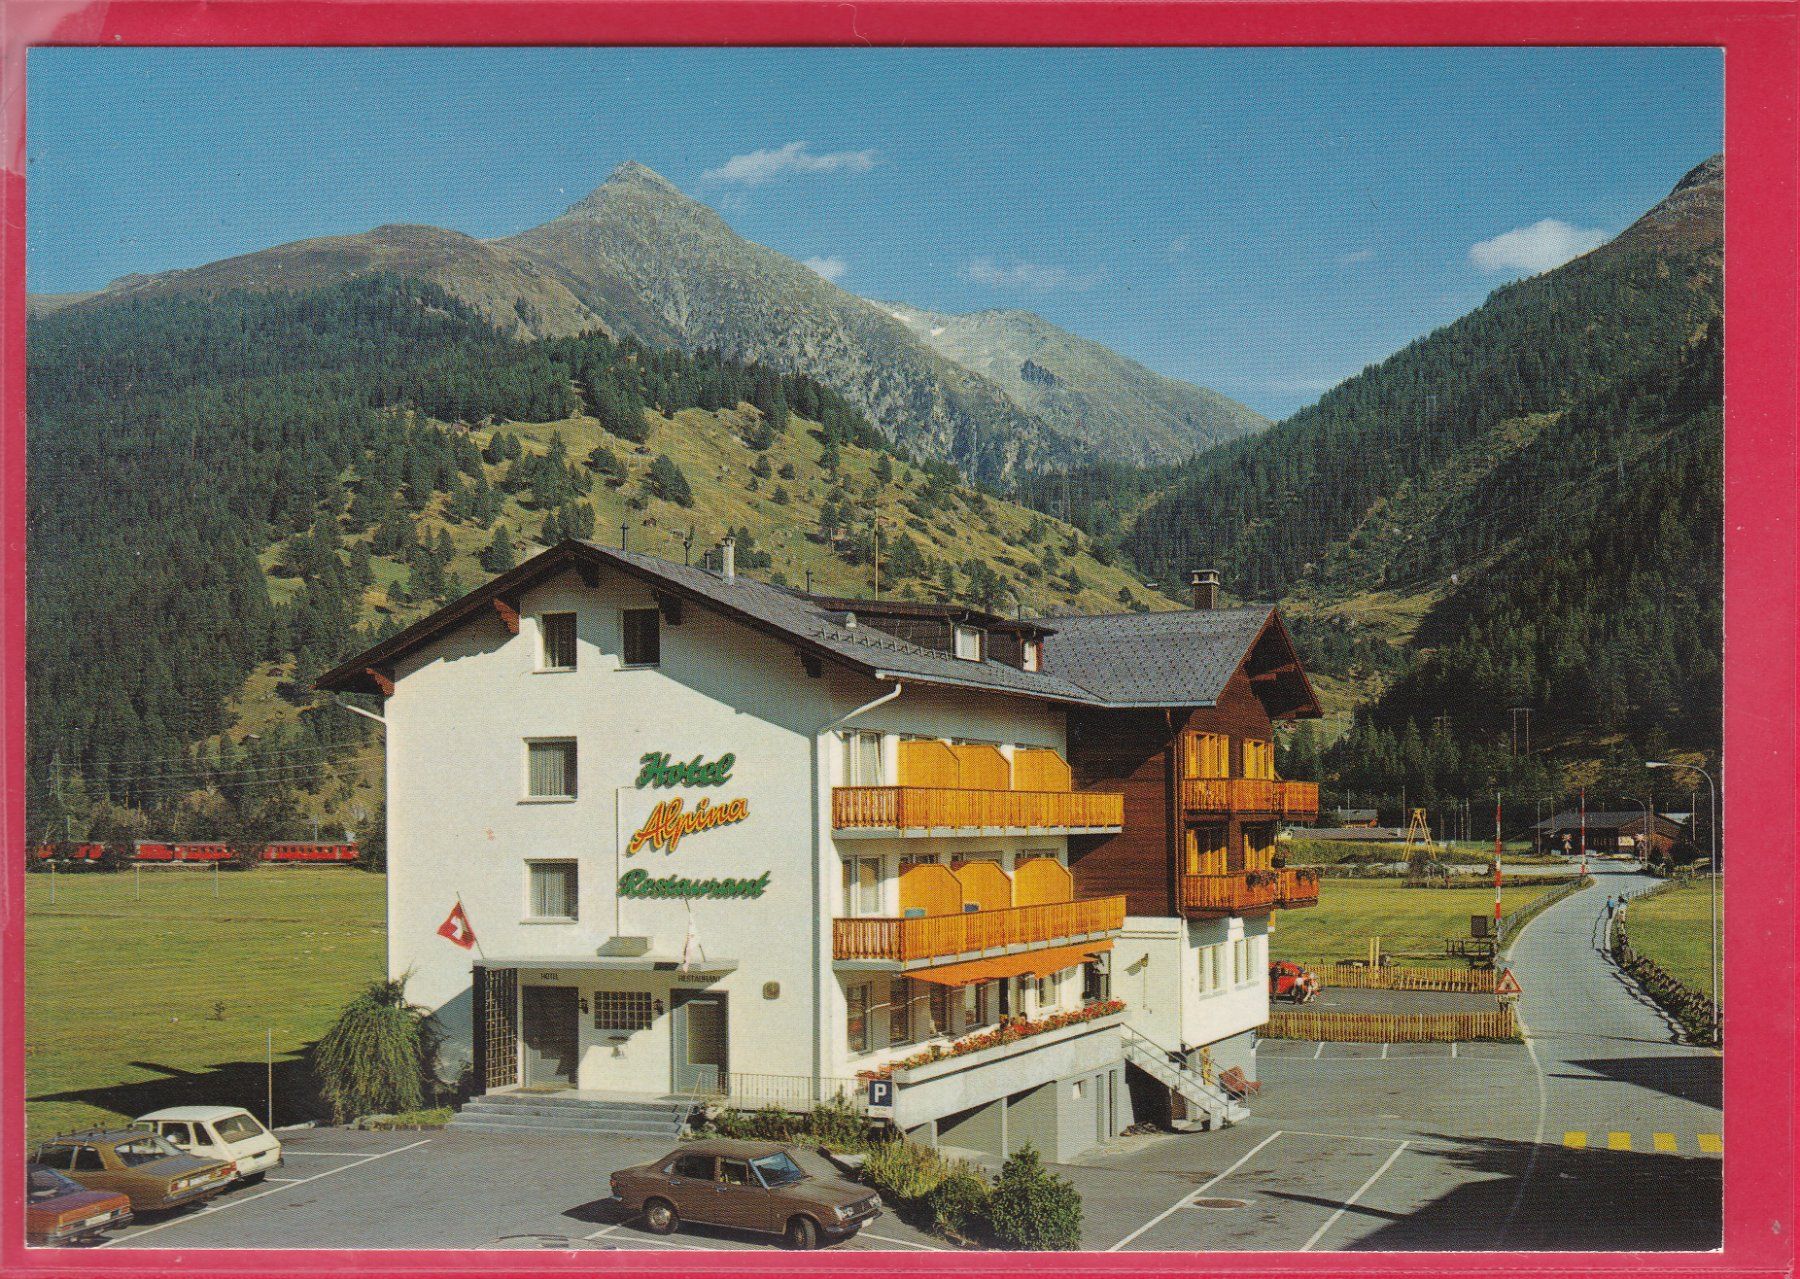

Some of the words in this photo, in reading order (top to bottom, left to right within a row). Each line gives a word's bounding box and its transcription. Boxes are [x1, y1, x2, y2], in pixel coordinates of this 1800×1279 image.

[635, 751, 736, 789] Hotel
[625, 797, 750, 857] Alpina
[616, 868, 771, 900] Restaurant
[540, 972, 560, 981] HOTEL
[874, 1083, 887, 1103] P
